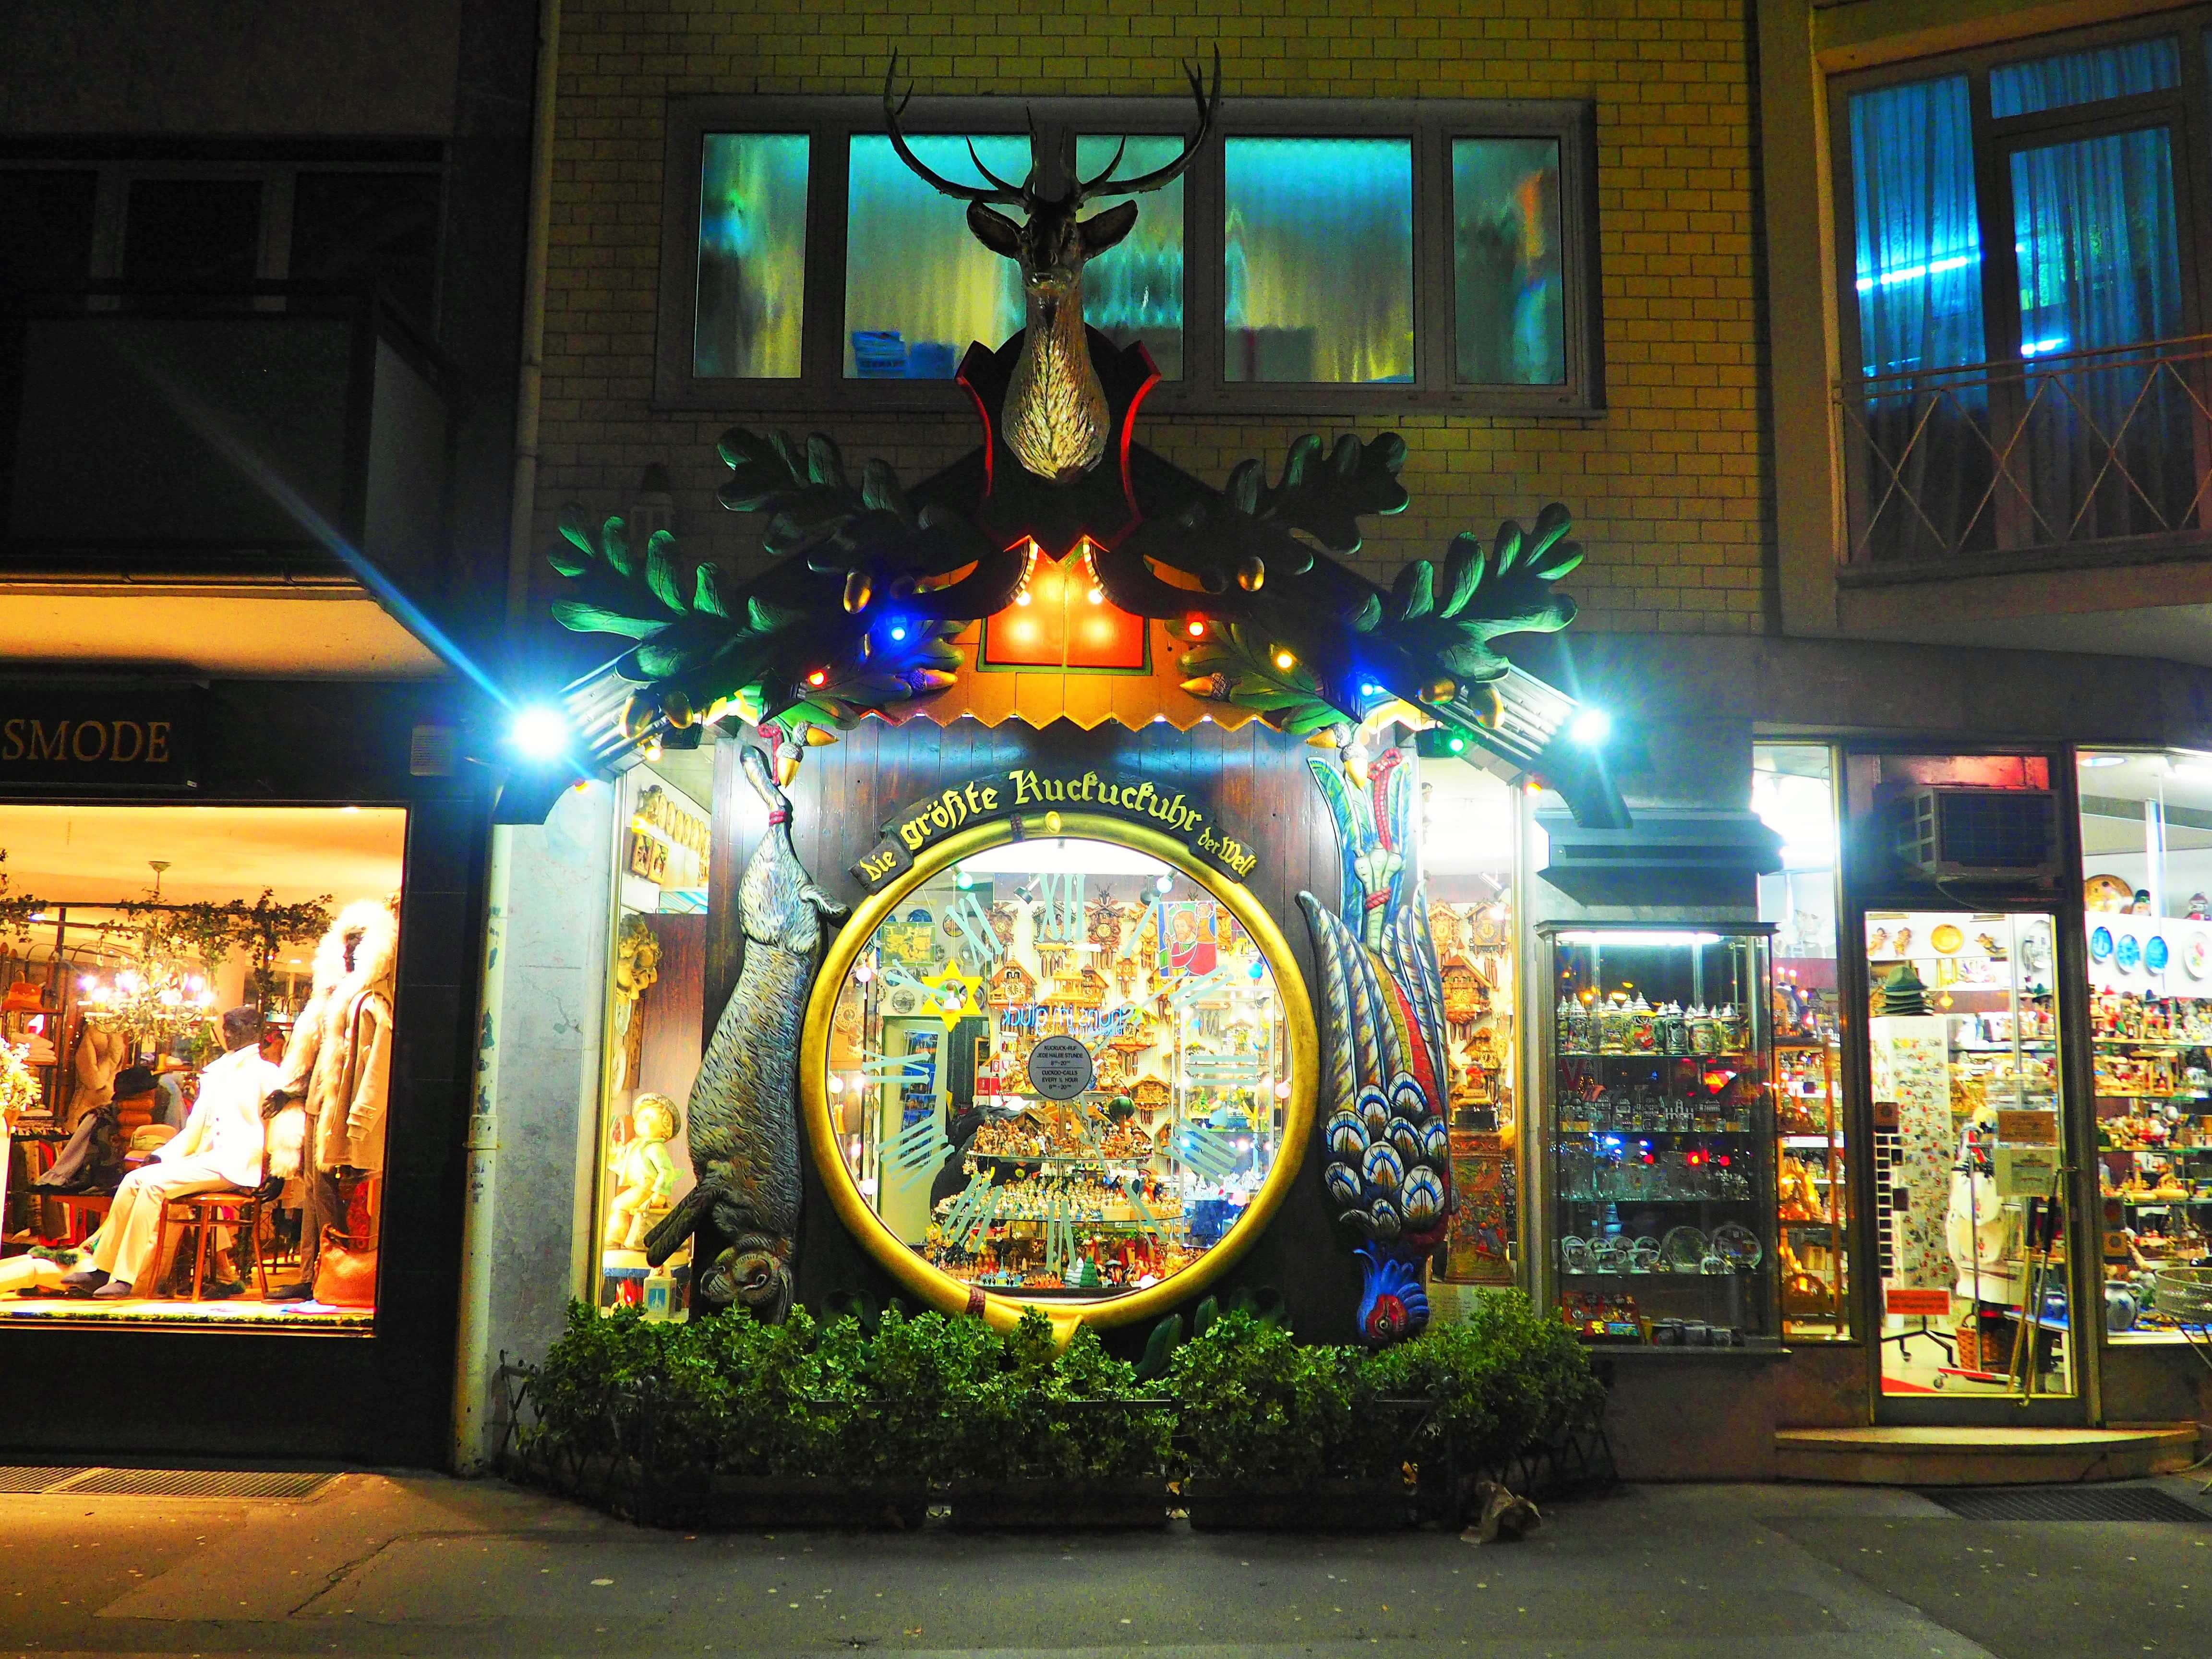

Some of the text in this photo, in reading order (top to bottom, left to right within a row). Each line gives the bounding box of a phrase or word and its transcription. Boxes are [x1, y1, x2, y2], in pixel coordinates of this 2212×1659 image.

[1, 719, 171, 762] SMODE
[860, 769, 1257, 882] Die größte Kuckuckuhr der Welt
